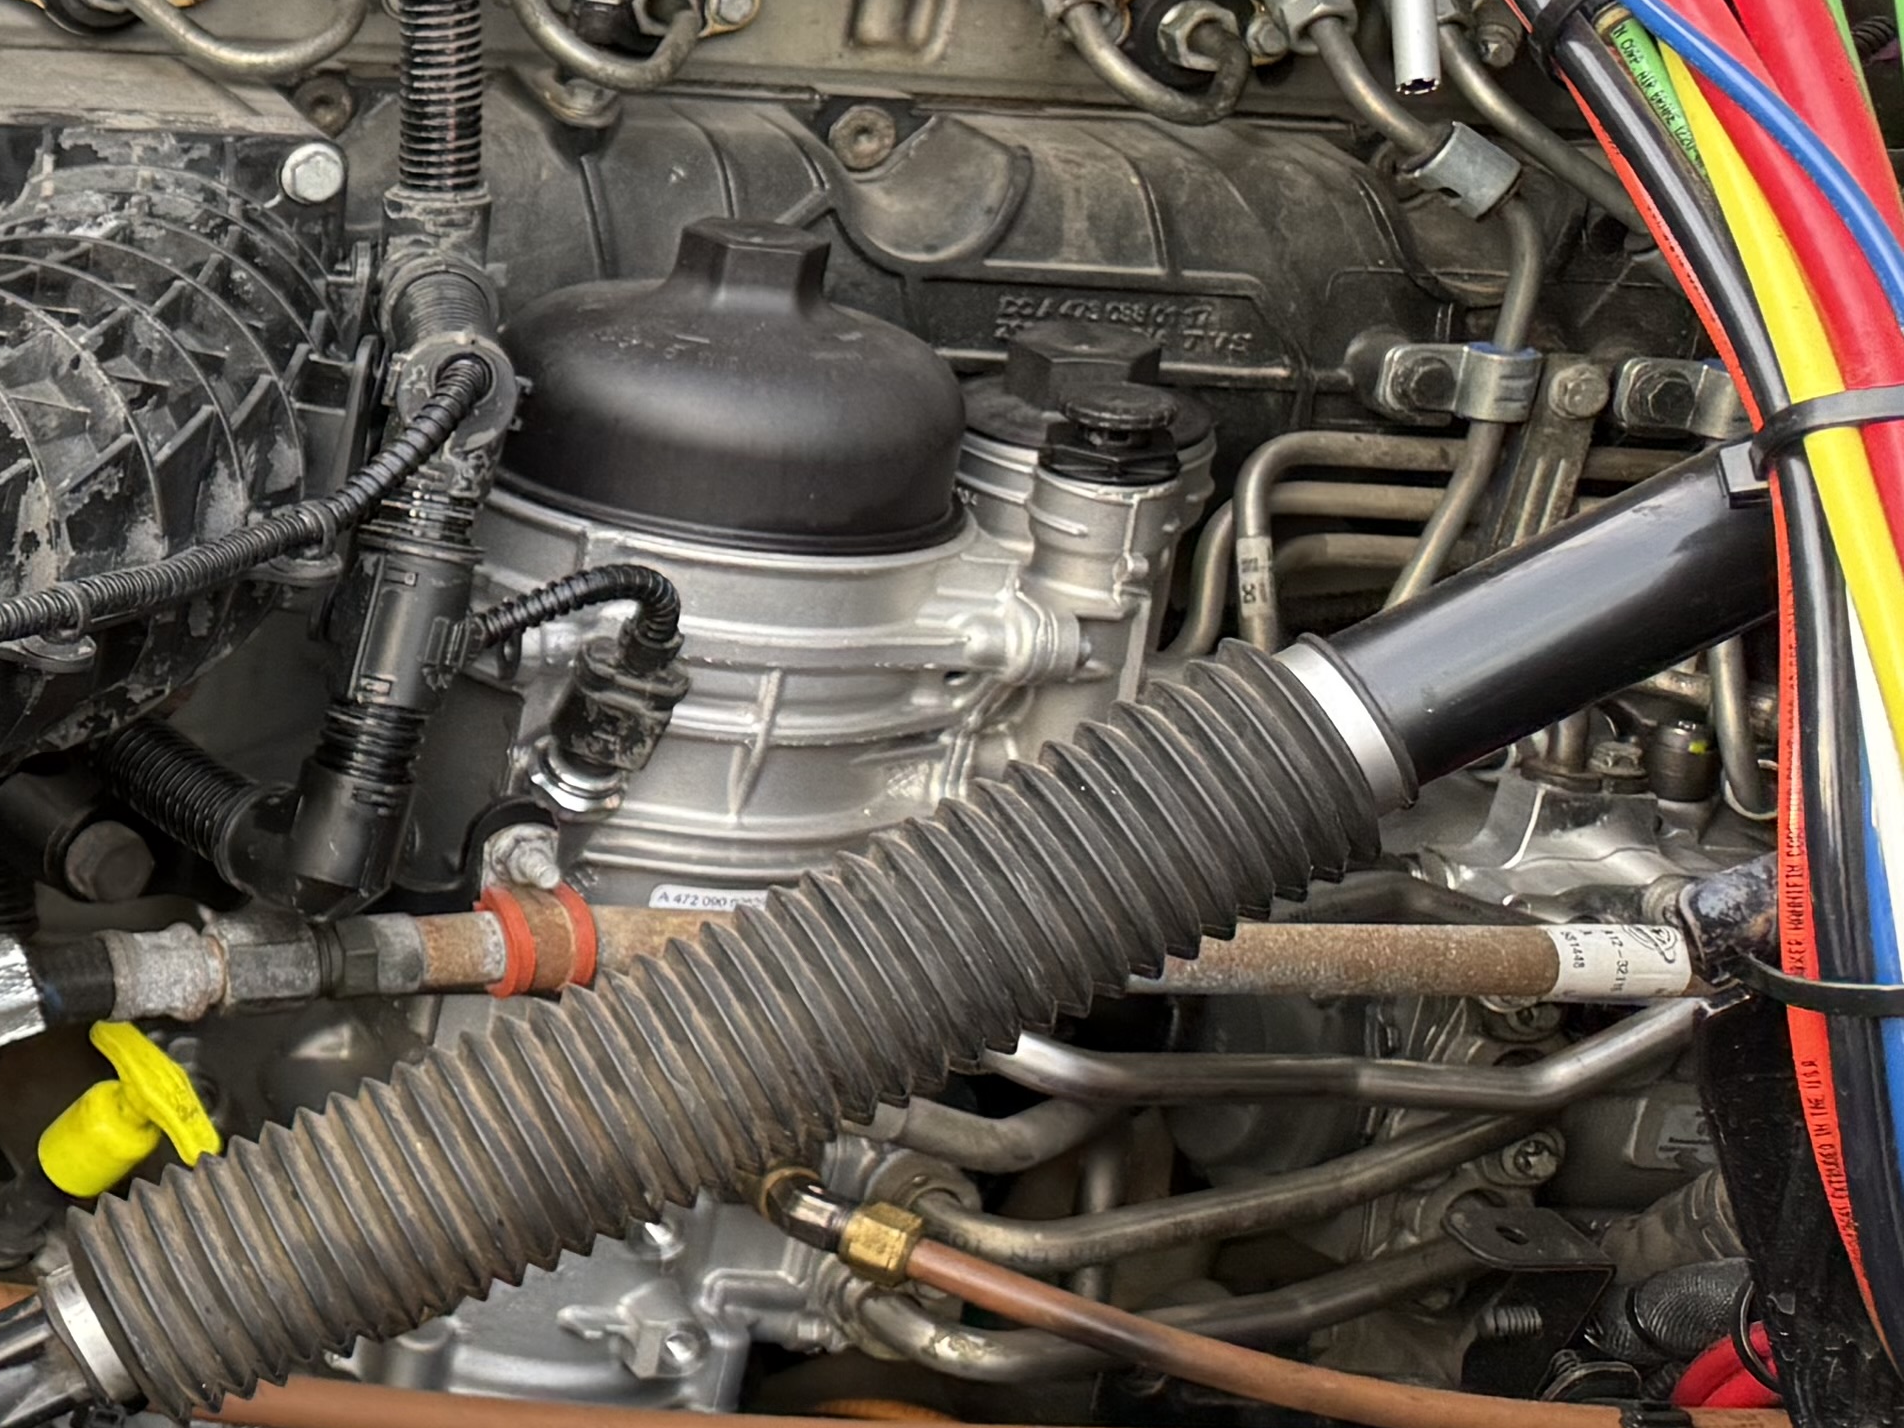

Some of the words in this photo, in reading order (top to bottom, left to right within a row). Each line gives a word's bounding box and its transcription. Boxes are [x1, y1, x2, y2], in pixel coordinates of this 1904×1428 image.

[658, 891, 669, 902] A
[673, 894, 698, 906] 472
[702, 897, 727, 907] 090
